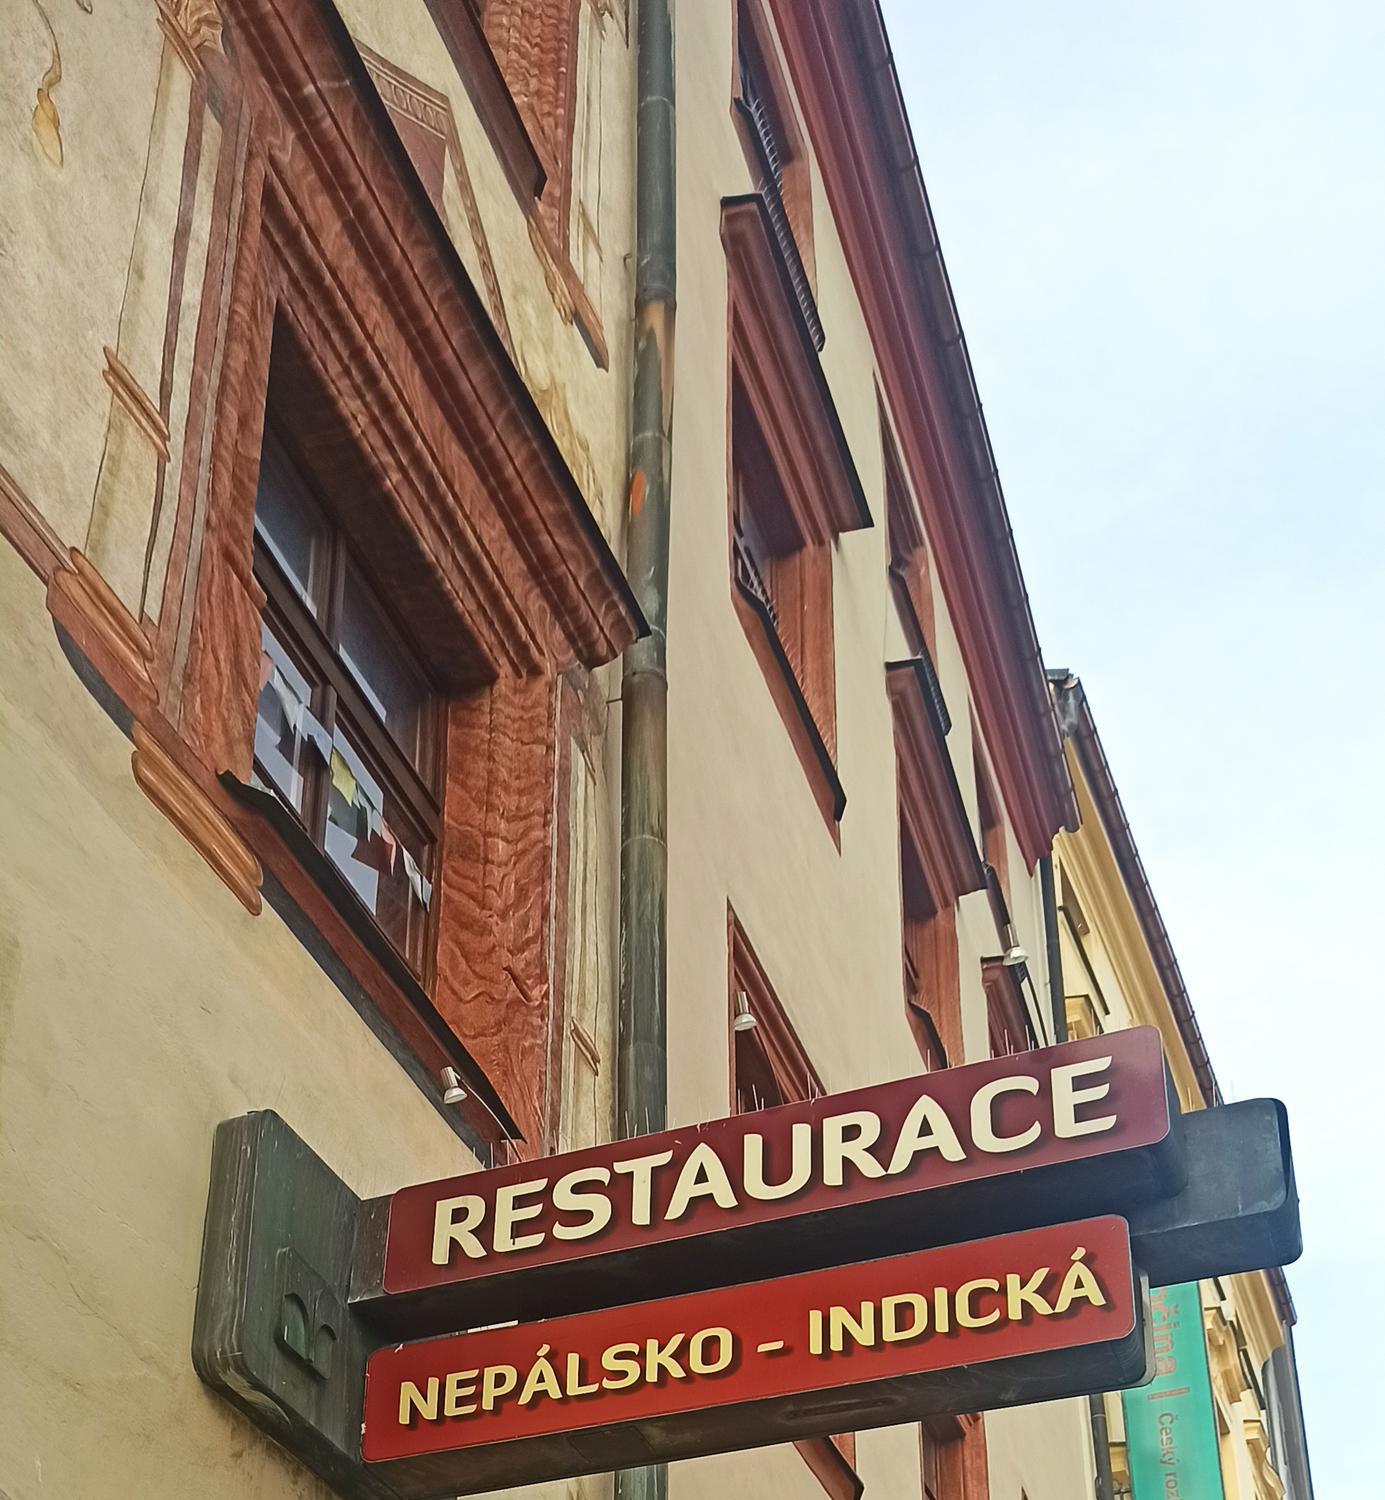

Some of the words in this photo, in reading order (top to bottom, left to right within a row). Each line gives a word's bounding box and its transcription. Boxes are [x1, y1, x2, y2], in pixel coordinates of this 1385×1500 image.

[432, 1055, 1117, 1265] RESTAURACE
[398, 1326, 734, 1425] NEPÁLSKO
[808, 1246, 1107, 1356] INDICKÁ
[1158, 1413, 1180, 1465] Český
